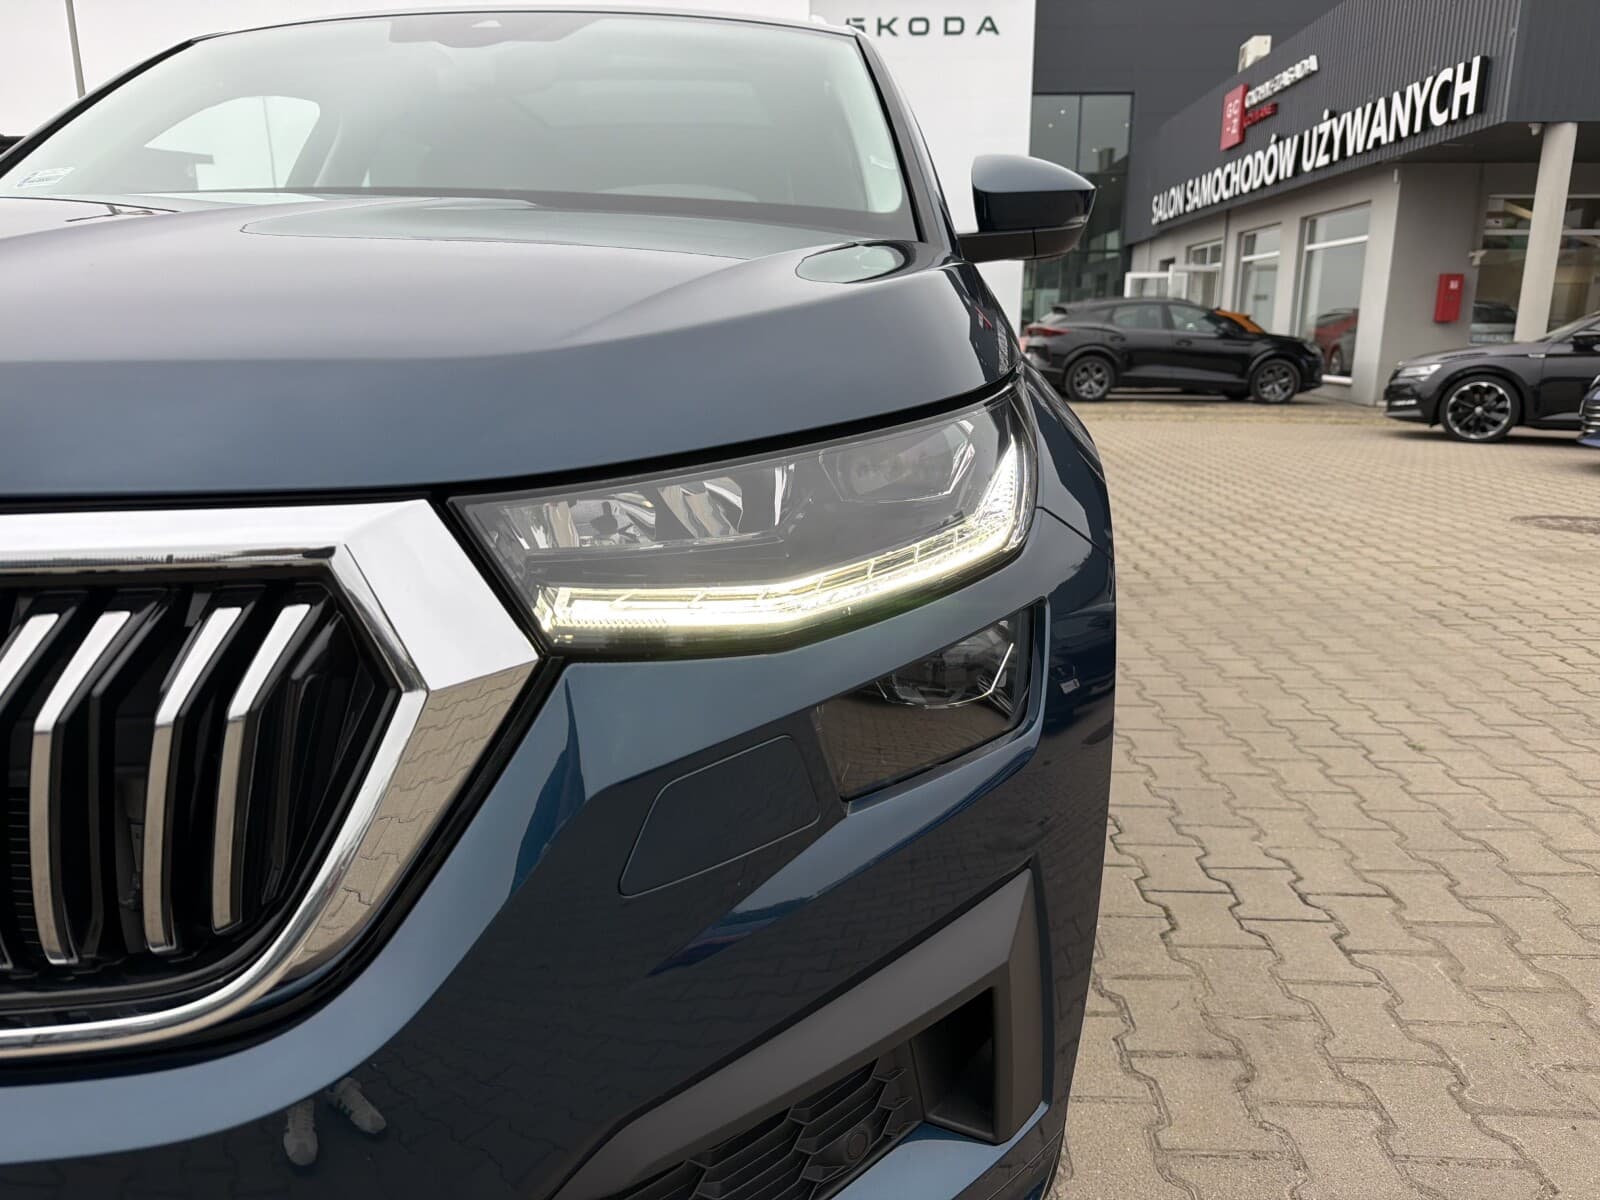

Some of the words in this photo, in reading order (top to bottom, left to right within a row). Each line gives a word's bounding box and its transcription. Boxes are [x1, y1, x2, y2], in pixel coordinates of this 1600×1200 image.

[1151, 182, 1185, 225] SALON
[1185, 133, 1299, 211] SAMOCHODÓW
[1302, 55, 1481, 172] UŻYWANYCH
